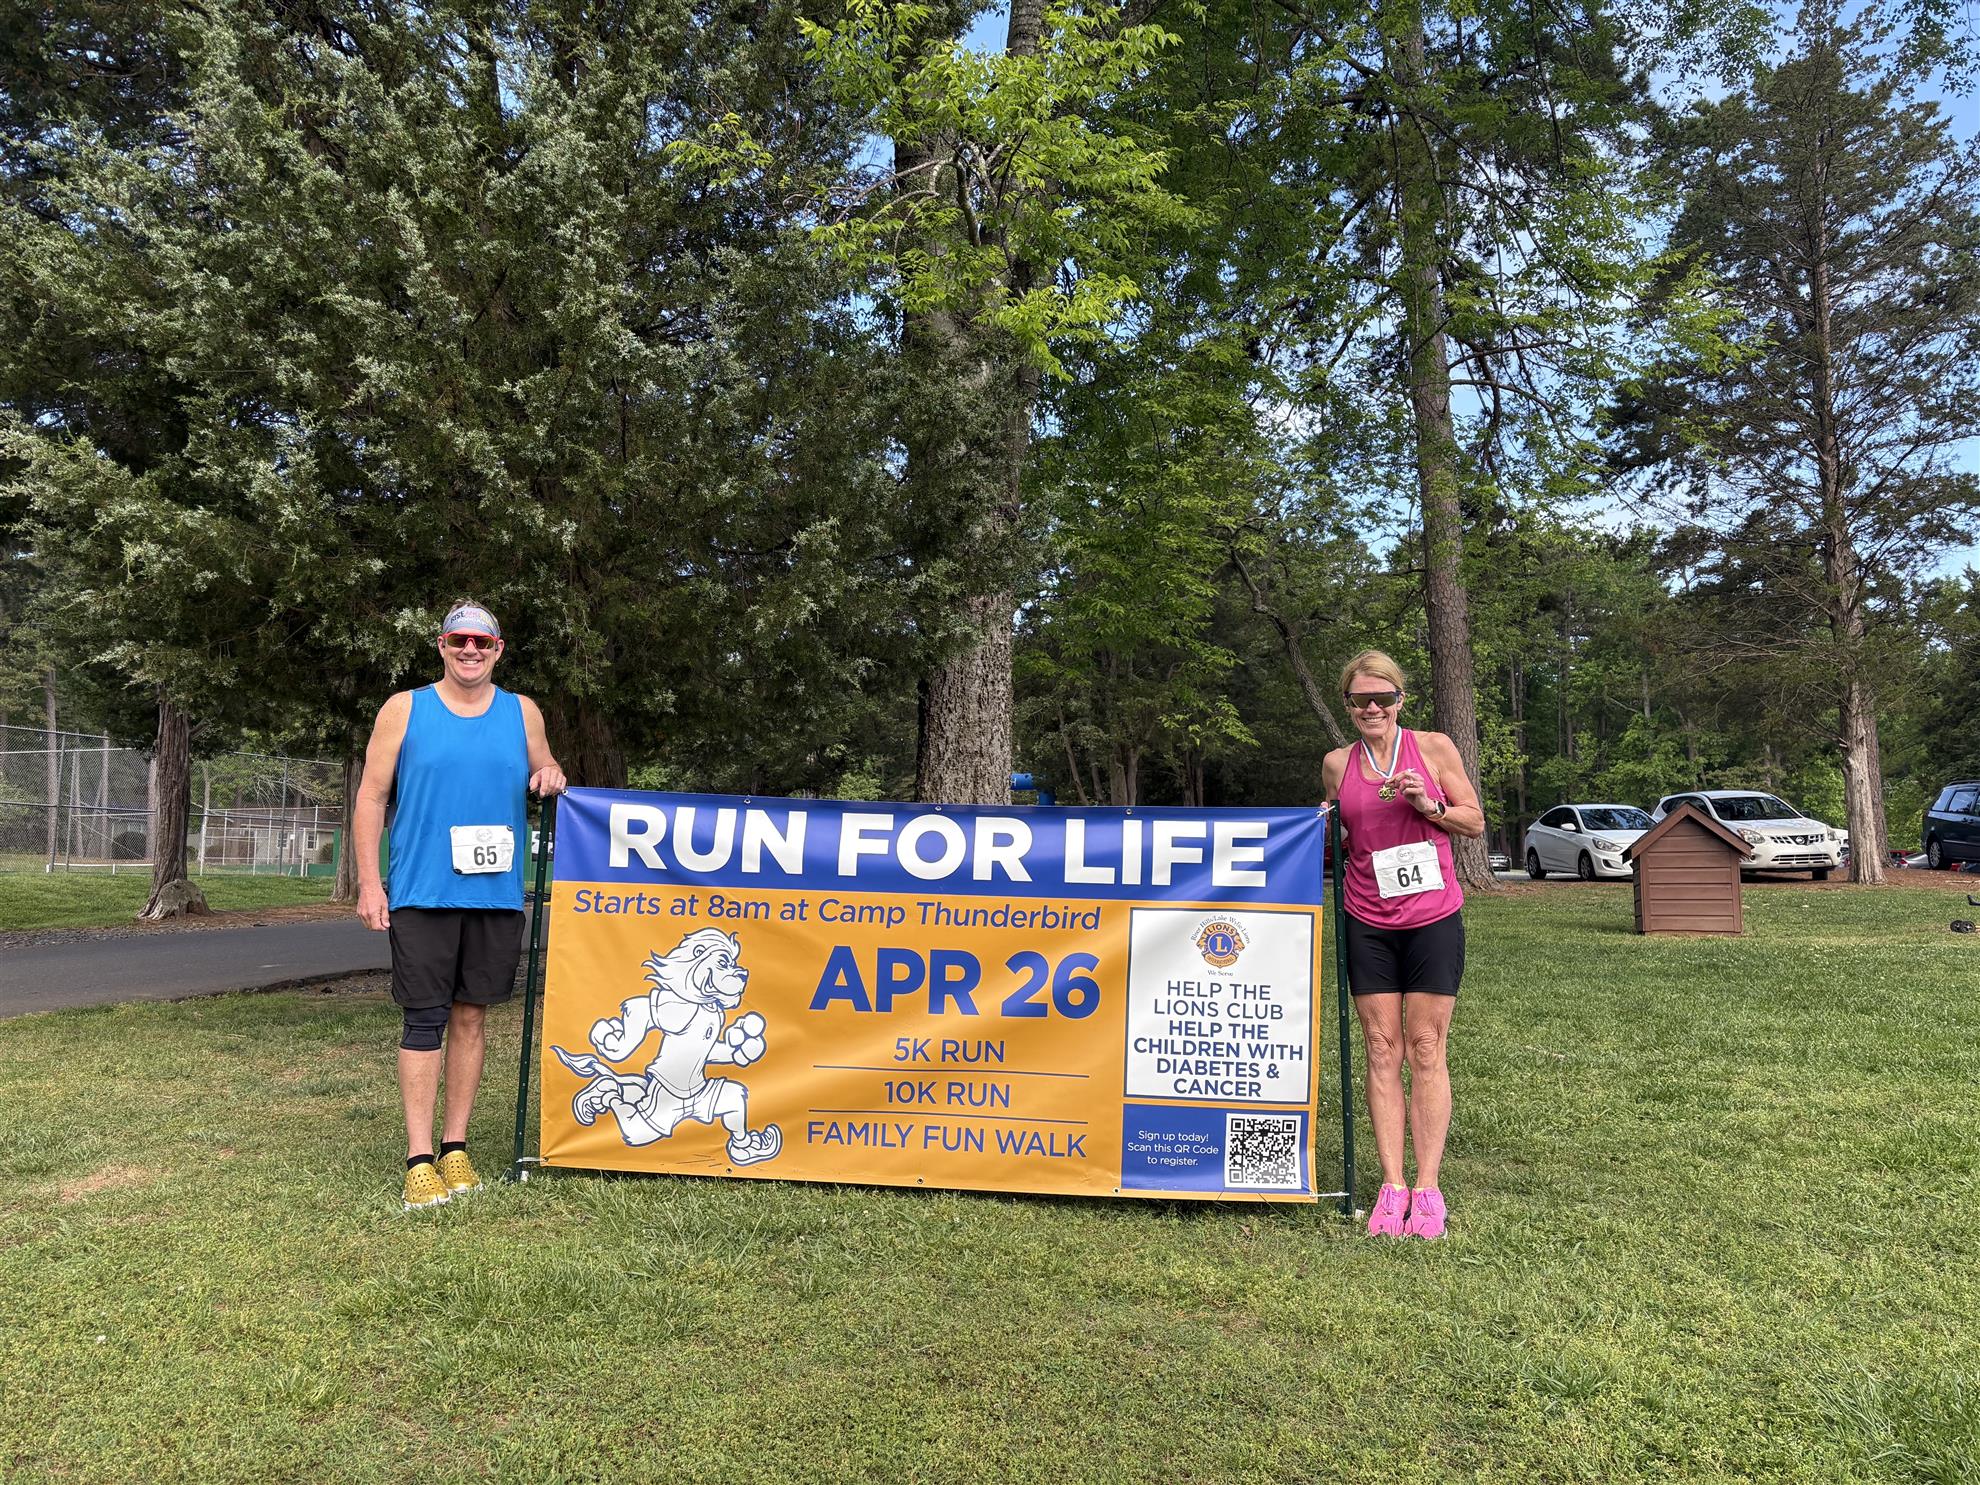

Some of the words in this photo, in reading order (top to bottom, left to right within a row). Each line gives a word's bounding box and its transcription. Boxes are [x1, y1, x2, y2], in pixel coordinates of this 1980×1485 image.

[473, 845, 497, 866] 65
[608, 803, 807, 875] RUN
[838, 813, 1033, 882] FOR
[1064, 818, 1269, 887] LIFE
[1397, 865, 1423, 888] 64
[573, 889, 661, 915] Starts
[670, 894, 699, 917] at
[707, 894, 770, 920] 8am
[780, 898, 809, 922] at
[818, 898, 906, 929] Camp
[916, 901, 1101, 930] Thunderbird
[1207, 924, 1235, 935] LIONS
[1215, 936, 1228, 952] L
[808, 945, 982, 1016] APR
[1000, 950, 1101, 1019] 26
[1167, 980, 1222, 998] HELP
[1229, 983, 1271, 1001] THE
[1154, 998, 1219, 1017] LIONS
[1226, 1002, 1283, 1020] CLUB
[1169, 1020, 1223, 1038] HELP
[1228, 1023, 1269, 1040] THE
[893, 1037, 932, 1062] 5K
[941, 1039, 1005, 1063] RUN
[1133, 1037, 1240, 1058] CHILDREN
[1247, 1043, 1303, 1061] WITH
[1156, 1058, 1260, 1078] DIABETES
[1266, 1063, 1280, 1079] &
[884, 1080, 937, 1104] 10K
[946, 1081, 1010, 1108] RUN
[1173, 1078, 1262, 1097] CANCER
[806, 1121, 914, 1148] FAMILY
[923, 1125, 985, 1153] FUN
[995, 1129, 1088, 1158] WALK
[1138, 1130, 1160, 1141] Sign
[1162, 1133, 1175, 1142] up
[1178, 1133, 1209, 1143] today!
[1127, 1142, 1151, 1152] Scan
[1154, 1143, 1171, 1153] this
[1174, 1144, 1190, 1153] QR
[1192, 1145, 1219, 1154] Code
[1147, 1156, 1157, 1164] to
[1160, 1156, 1198, 1166] register.
